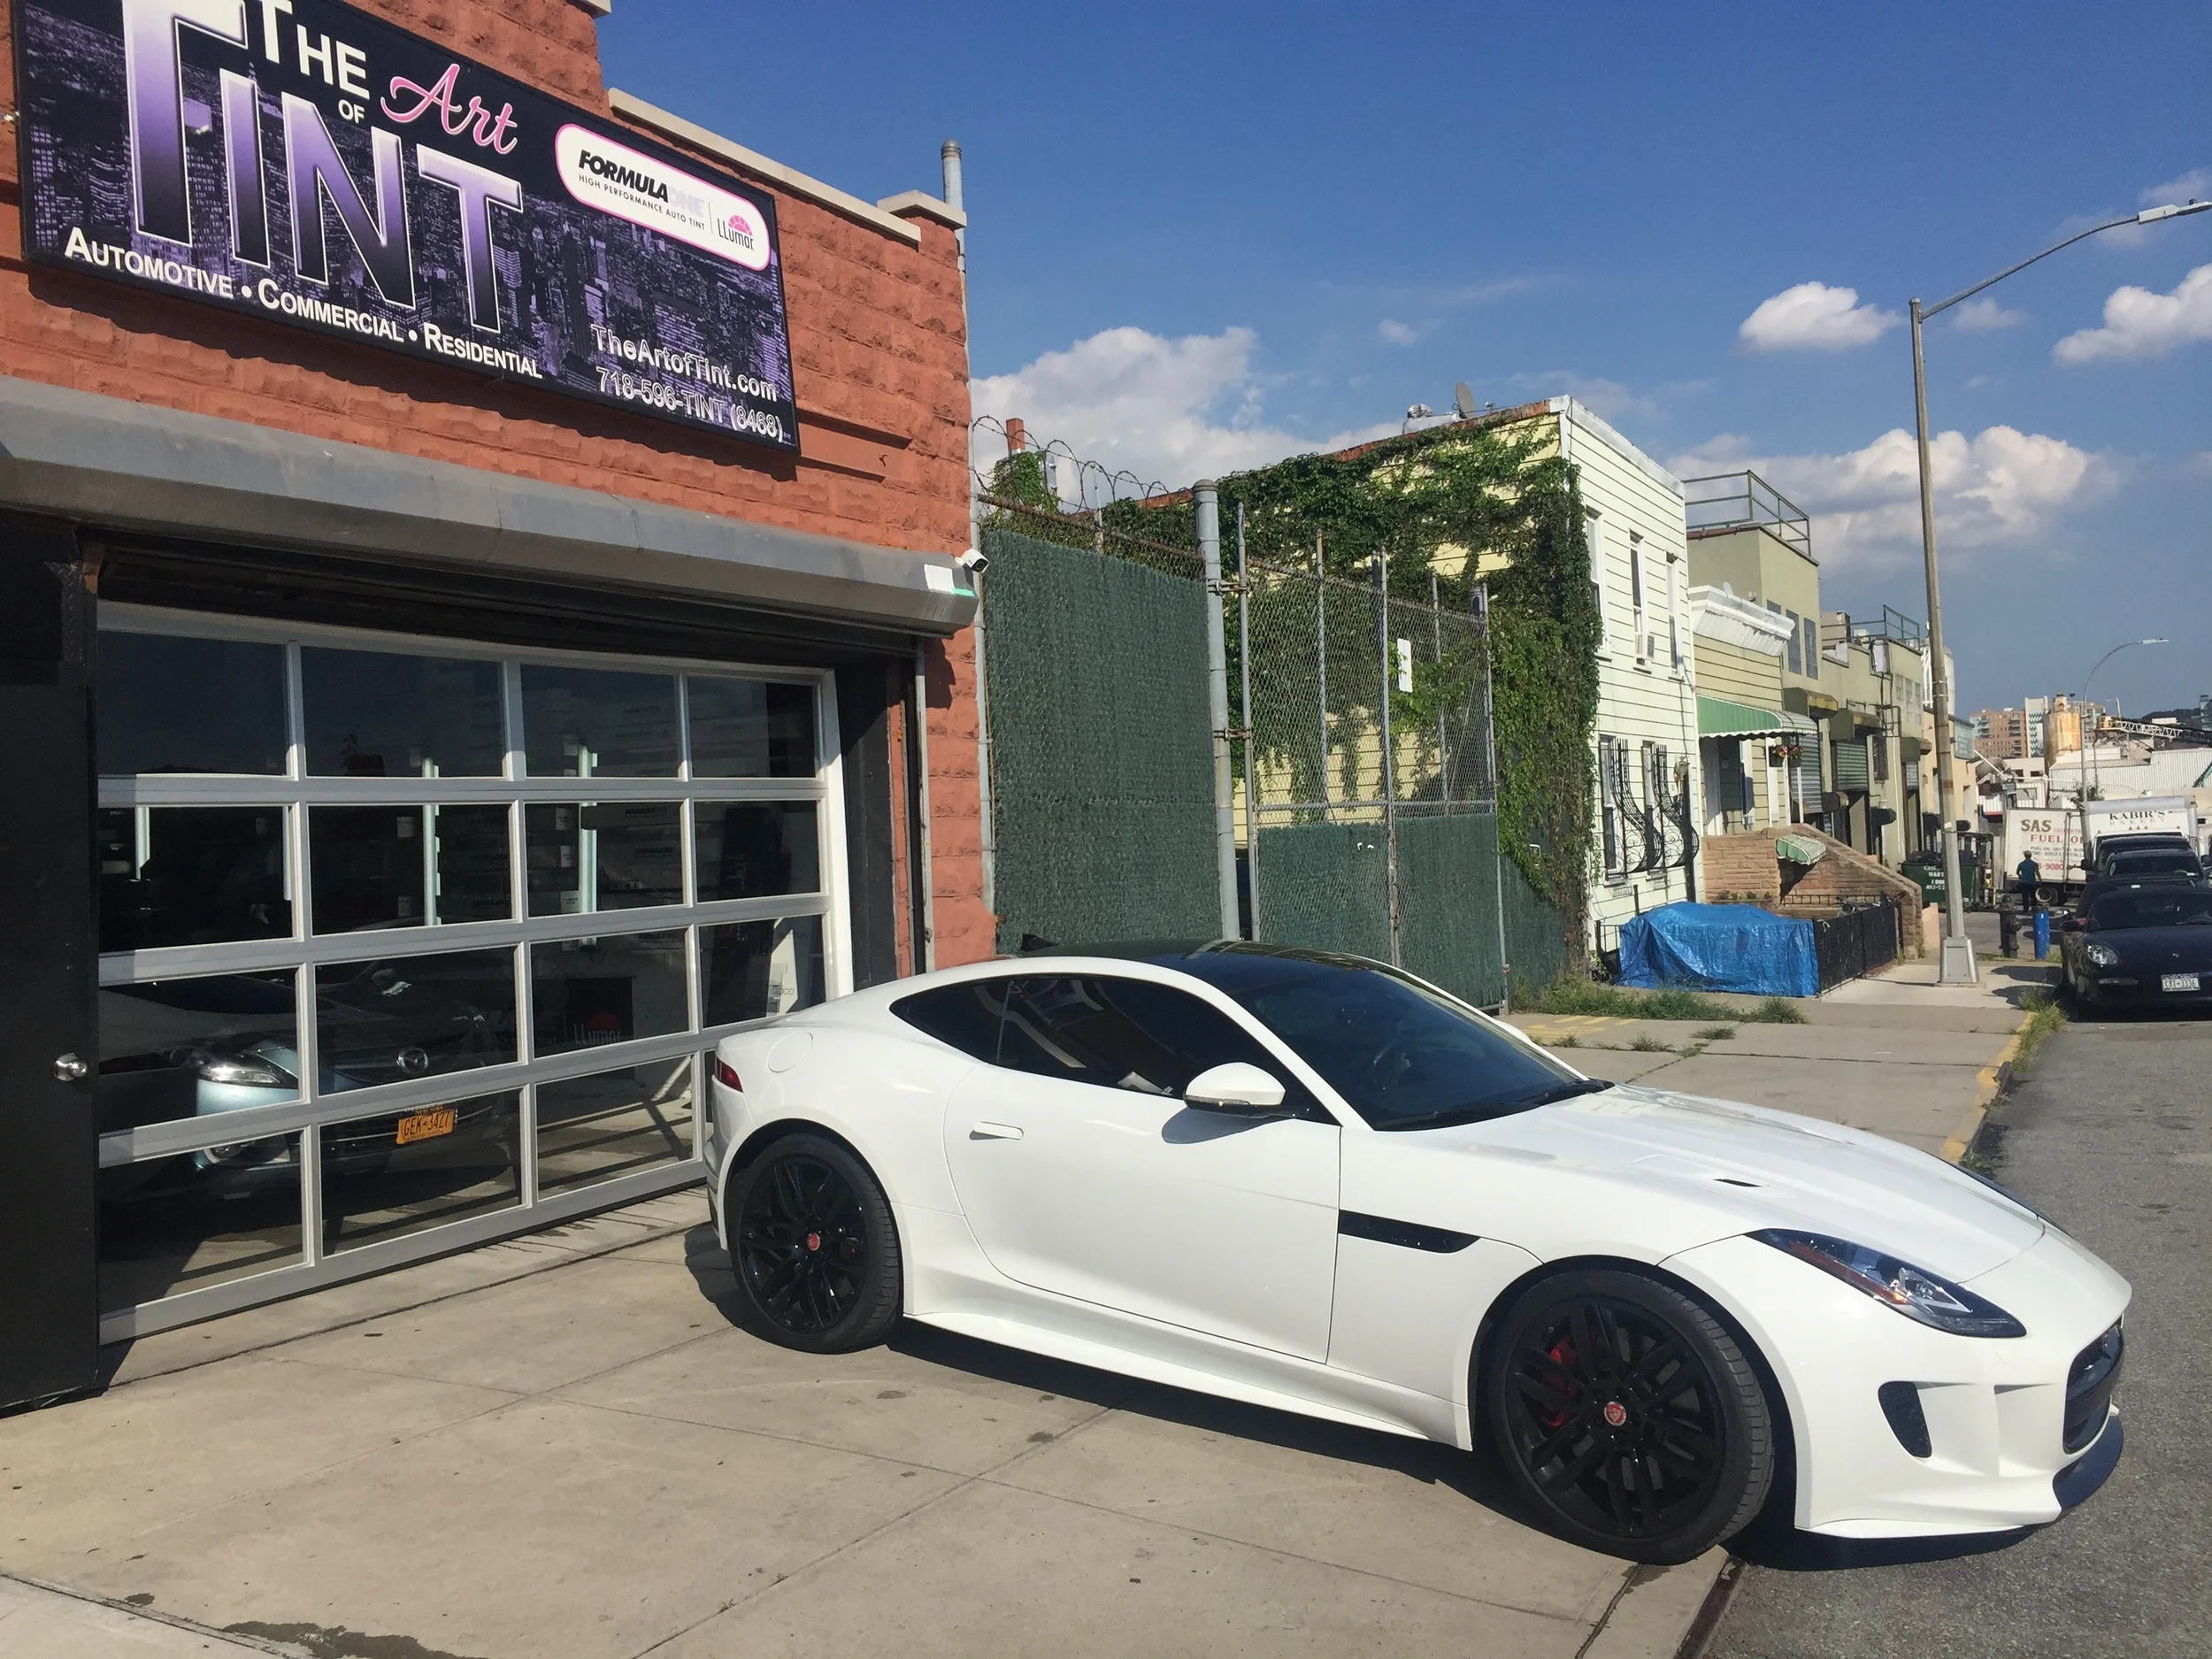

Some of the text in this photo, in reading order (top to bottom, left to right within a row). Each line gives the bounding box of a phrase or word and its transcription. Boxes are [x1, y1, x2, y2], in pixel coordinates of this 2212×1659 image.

[258, 0, 518, 154] THE Art
[339, 99, 365, 124] OF
[122, 0, 523, 334] TINT
[579, 173, 705, 230] HIGH PERFORMANCE AUTO TINT
[65, 227, 542, 380] AUTOMOTIVE COMMERCIAL RESIDENTIAL
[591, 324, 777, 402] TheArtofTint.com
[596, 365, 783, 442] 718-596-TINT (8468)
[2021, 818, 2052, 832] SAS
[2031, 834, 2063, 843] FUEL
[2109, 810, 2165, 820] KABIR'S
